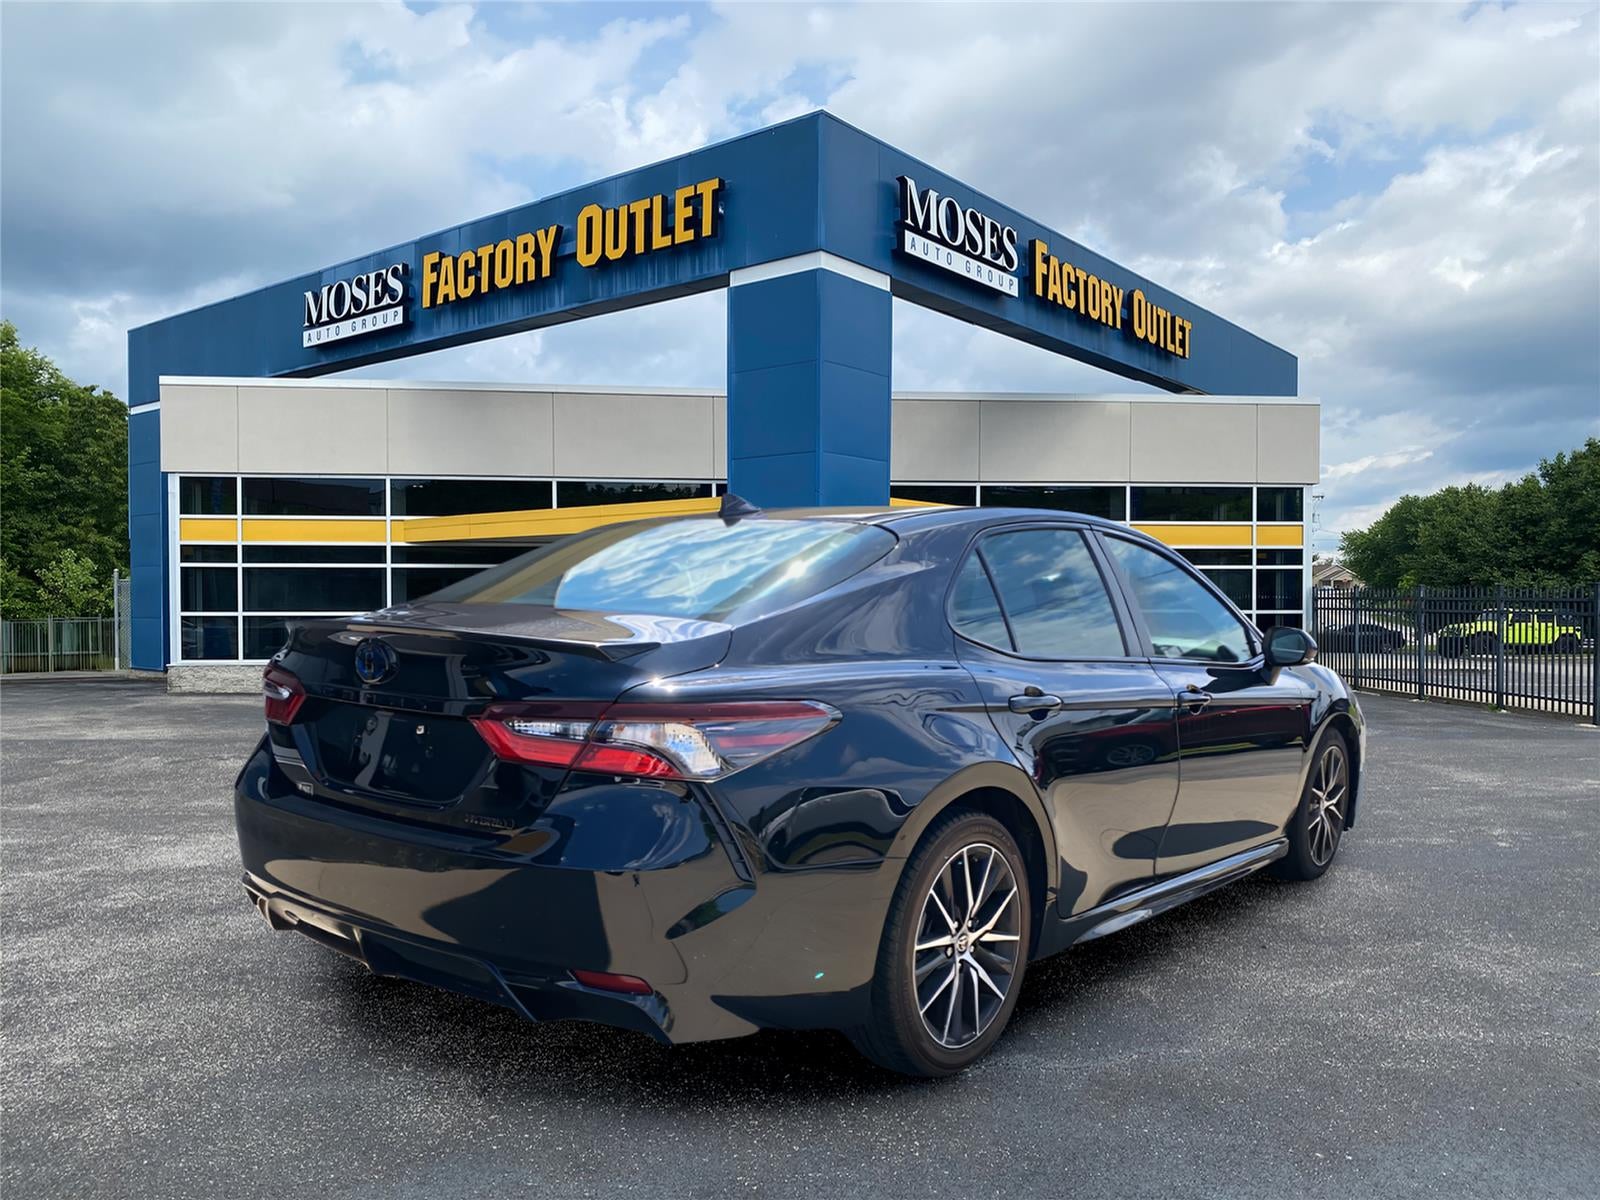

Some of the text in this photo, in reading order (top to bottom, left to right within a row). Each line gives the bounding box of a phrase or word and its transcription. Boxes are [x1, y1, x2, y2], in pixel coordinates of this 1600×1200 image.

[421, 177, 720, 309] FACTORY OUTLET
[904, 175, 1018, 272] MOSES
[303, 263, 405, 327] MOSES
[910, 237, 1015, 291] AUTO GROUP
[1035, 239, 1192, 358] FACTORY OUTLET
[306, 310, 400, 344] AUTO GROUP
